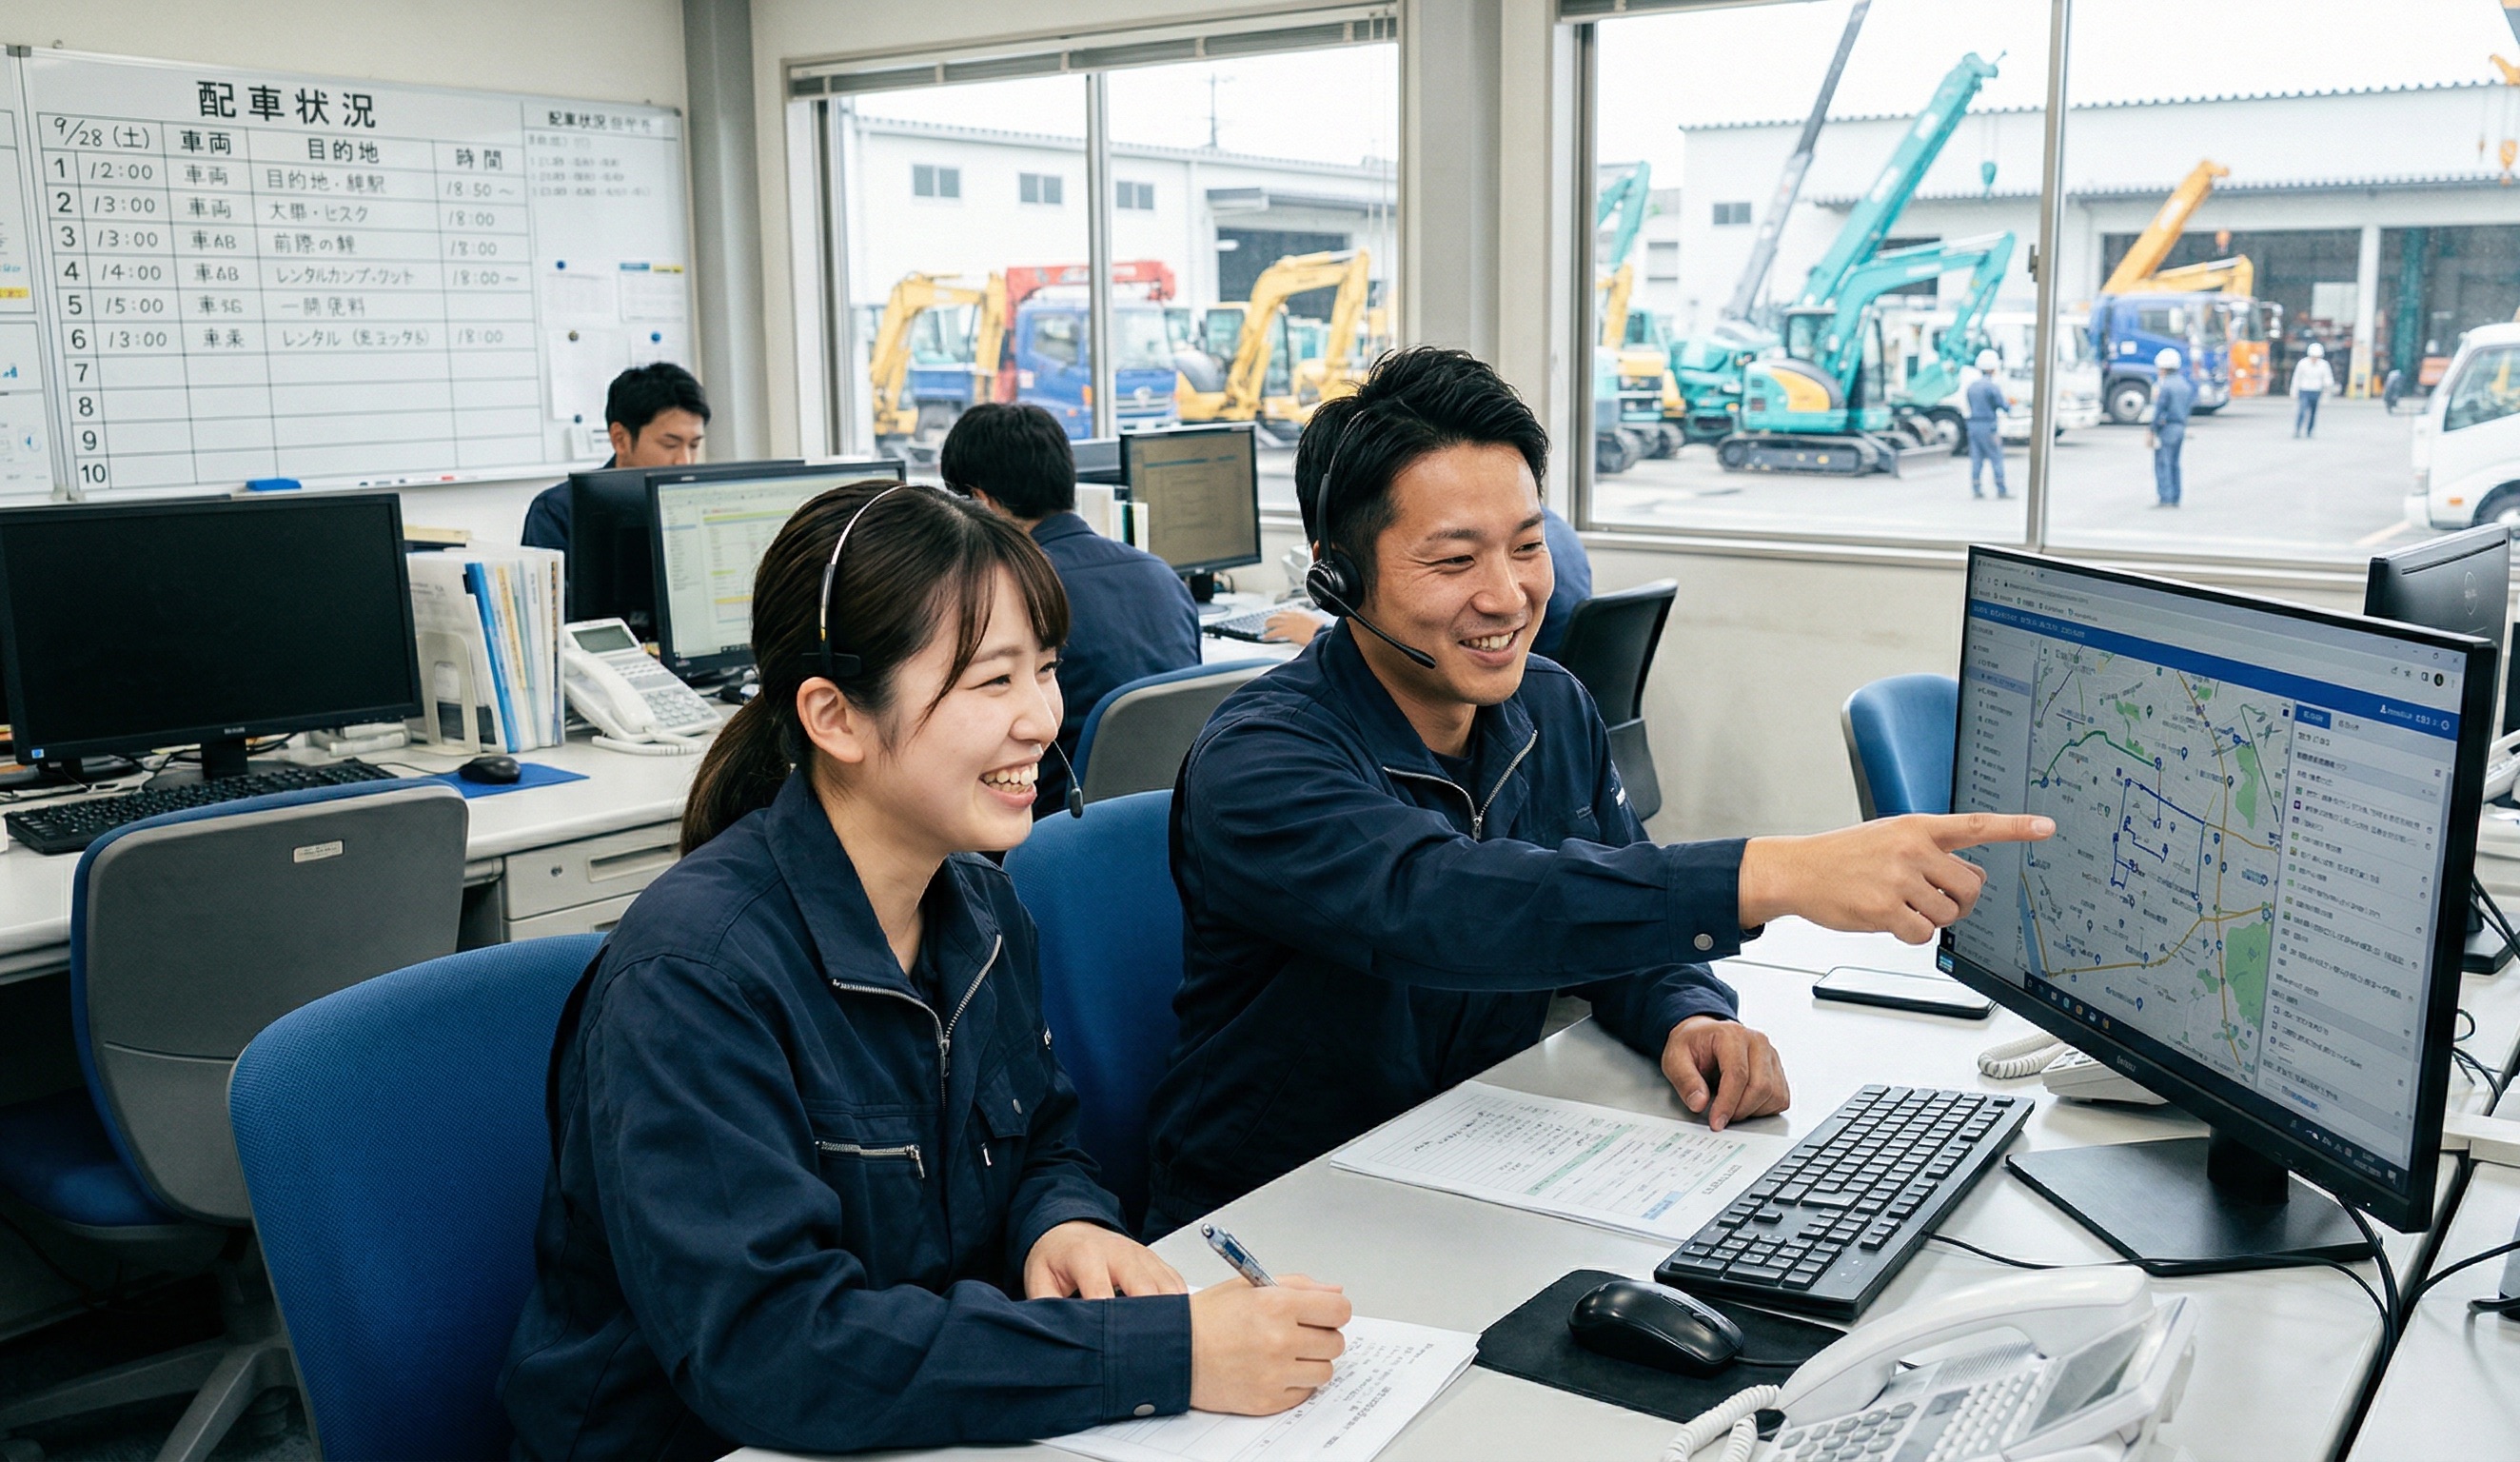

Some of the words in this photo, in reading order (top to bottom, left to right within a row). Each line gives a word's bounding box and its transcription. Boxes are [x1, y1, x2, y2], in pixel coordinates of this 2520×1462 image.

[196, 80, 376, 128] 配車状況
[180, 129, 231, 155] 車両
[307, 138, 380, 165] 目的地
[456, 148, 502, 170] 時間
[54, 158, 65, 178] 1
[57, 192, 72, 213] 2
[94, 196, 155, 213] 13:00
[61, 226, 76, 247] 3
[98, 230, 158, 247] 13:00
[64, 262, 81, 280] 4
[102, 265, 162, 280] 14:00
[68, 295, 82, 315] 5
[106, 297, 164, 314] 15:00
[71, 329, 87, 349] 6
[109, 331, 167, 348] 13:00
[74, 364, 89, 383] 7
[78, 396, 93, 417] 8
[82, 429, 97, 450] 9
[81, 464, 107, 484] 10
